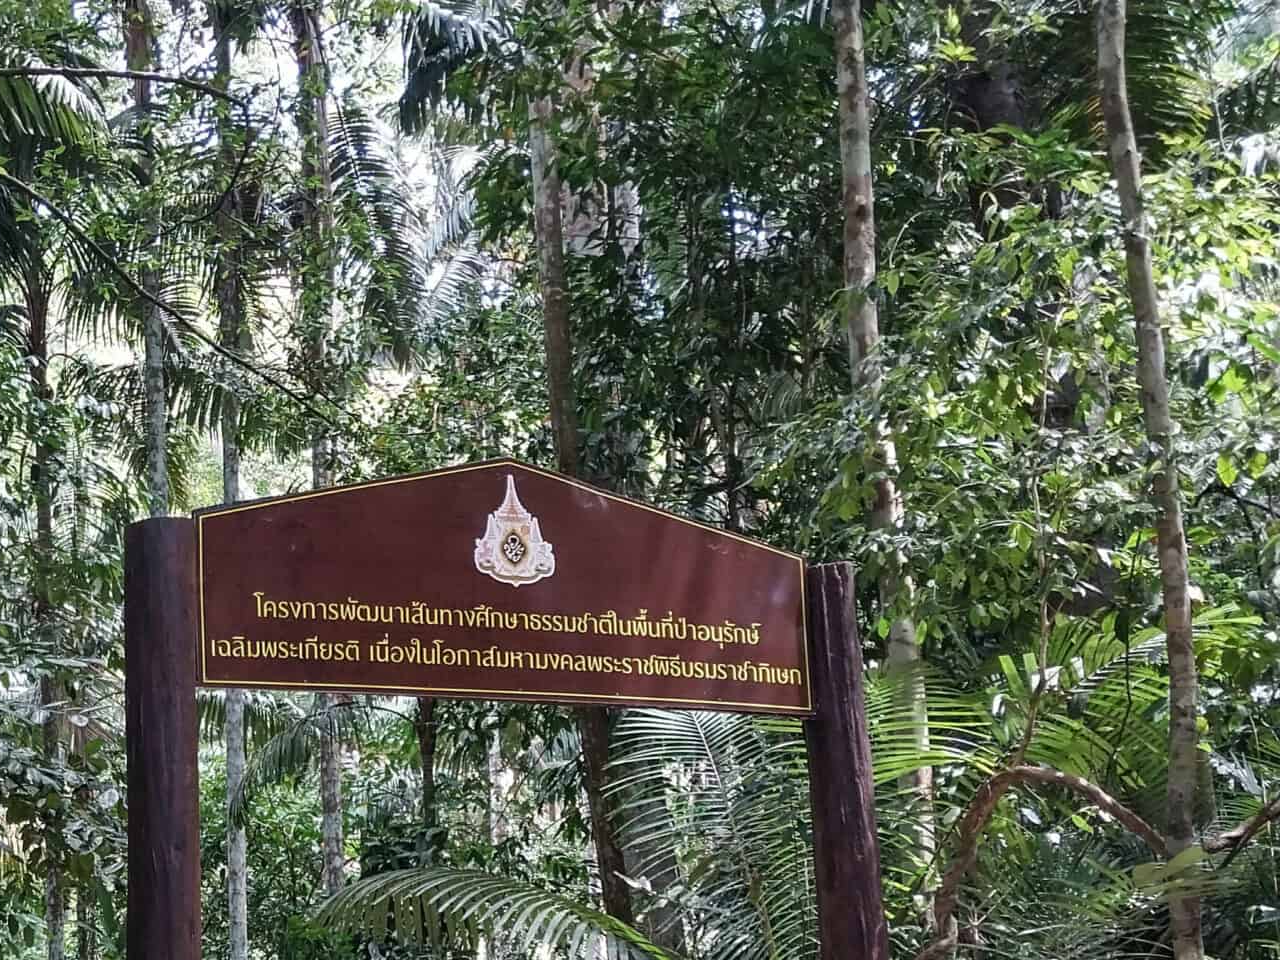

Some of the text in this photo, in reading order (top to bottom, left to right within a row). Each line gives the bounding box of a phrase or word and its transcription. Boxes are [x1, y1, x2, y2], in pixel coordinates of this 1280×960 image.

[253, 591, 761, 649] โครงการพัฒนาเส้นทางศึกษาธรรมชาติในพื้นที่ป่าอนุรักษ์
[210, 633, 802, 686] เฉลิมพระเกียรติ เนื่องในโอกาสมหามงคลพระราชพิธีบรมราชาภิเษก
